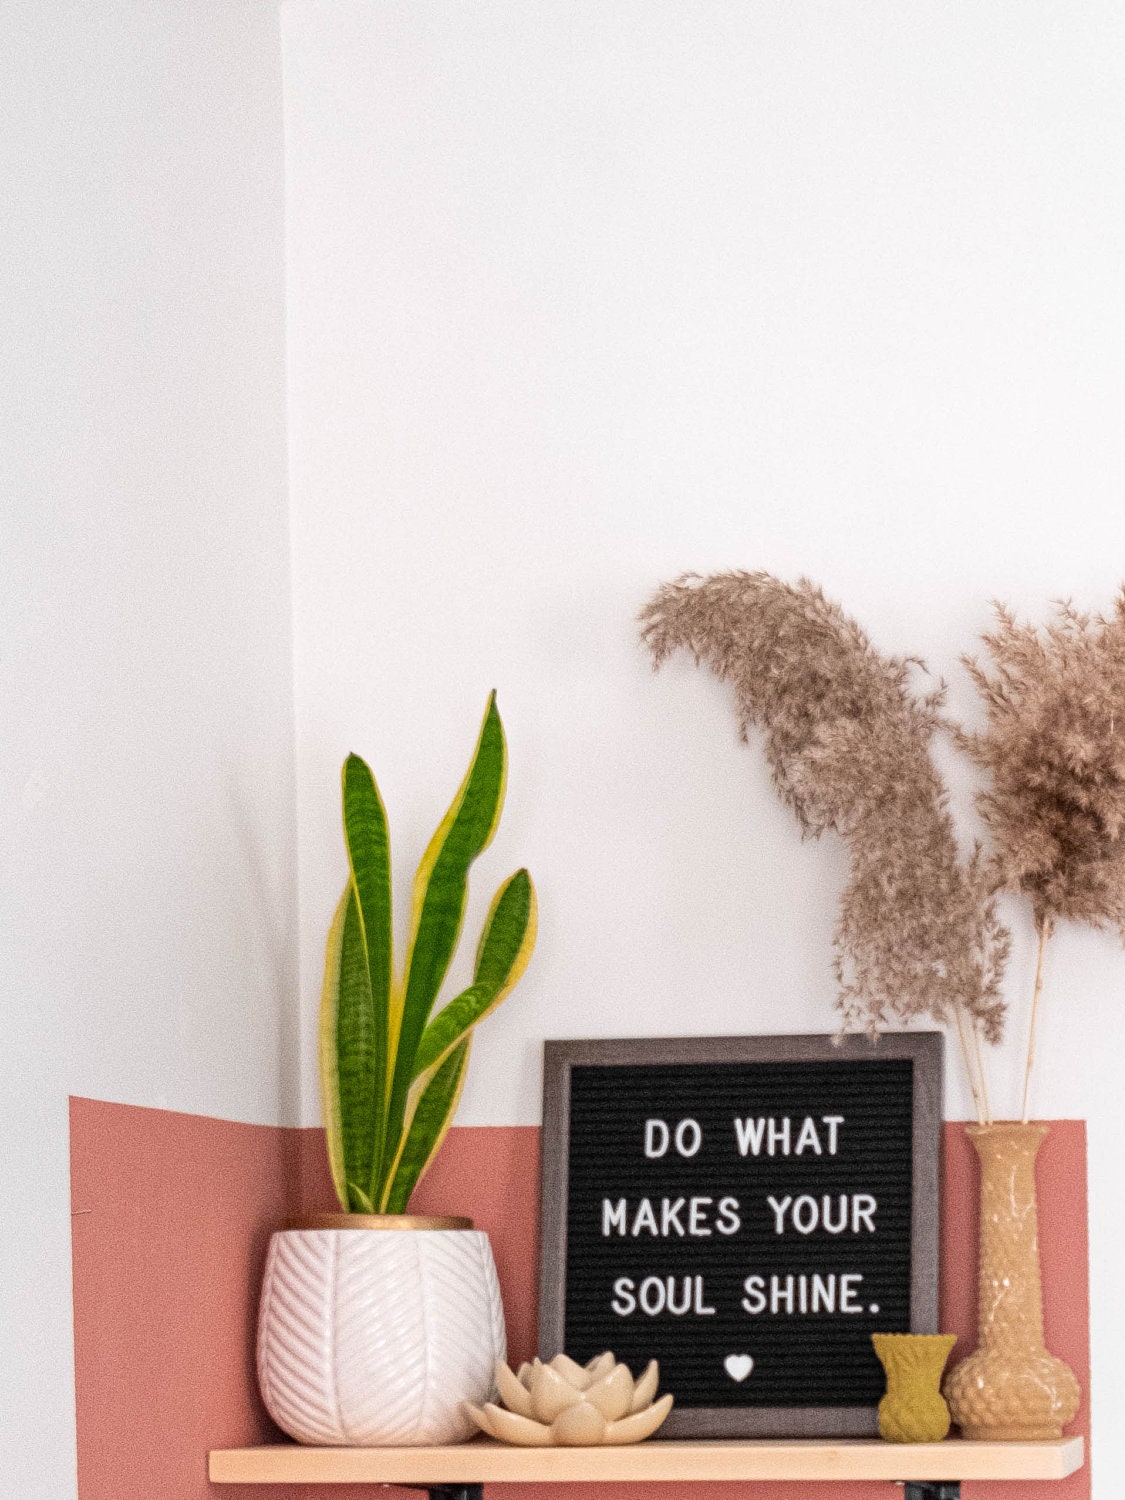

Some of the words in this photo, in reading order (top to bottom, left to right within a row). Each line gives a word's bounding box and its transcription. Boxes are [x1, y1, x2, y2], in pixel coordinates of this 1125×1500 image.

[644, 1118, 701, 1159] DO
[733, 1115, 845, 1157] WHAT
[602, 1196, 741, 1237] MAKES
[767, 1193, 877, 1235] YOUR
[611, 1275, 716, 1317] SOUL
[741, 1273, 880, 1315] SHINE.
